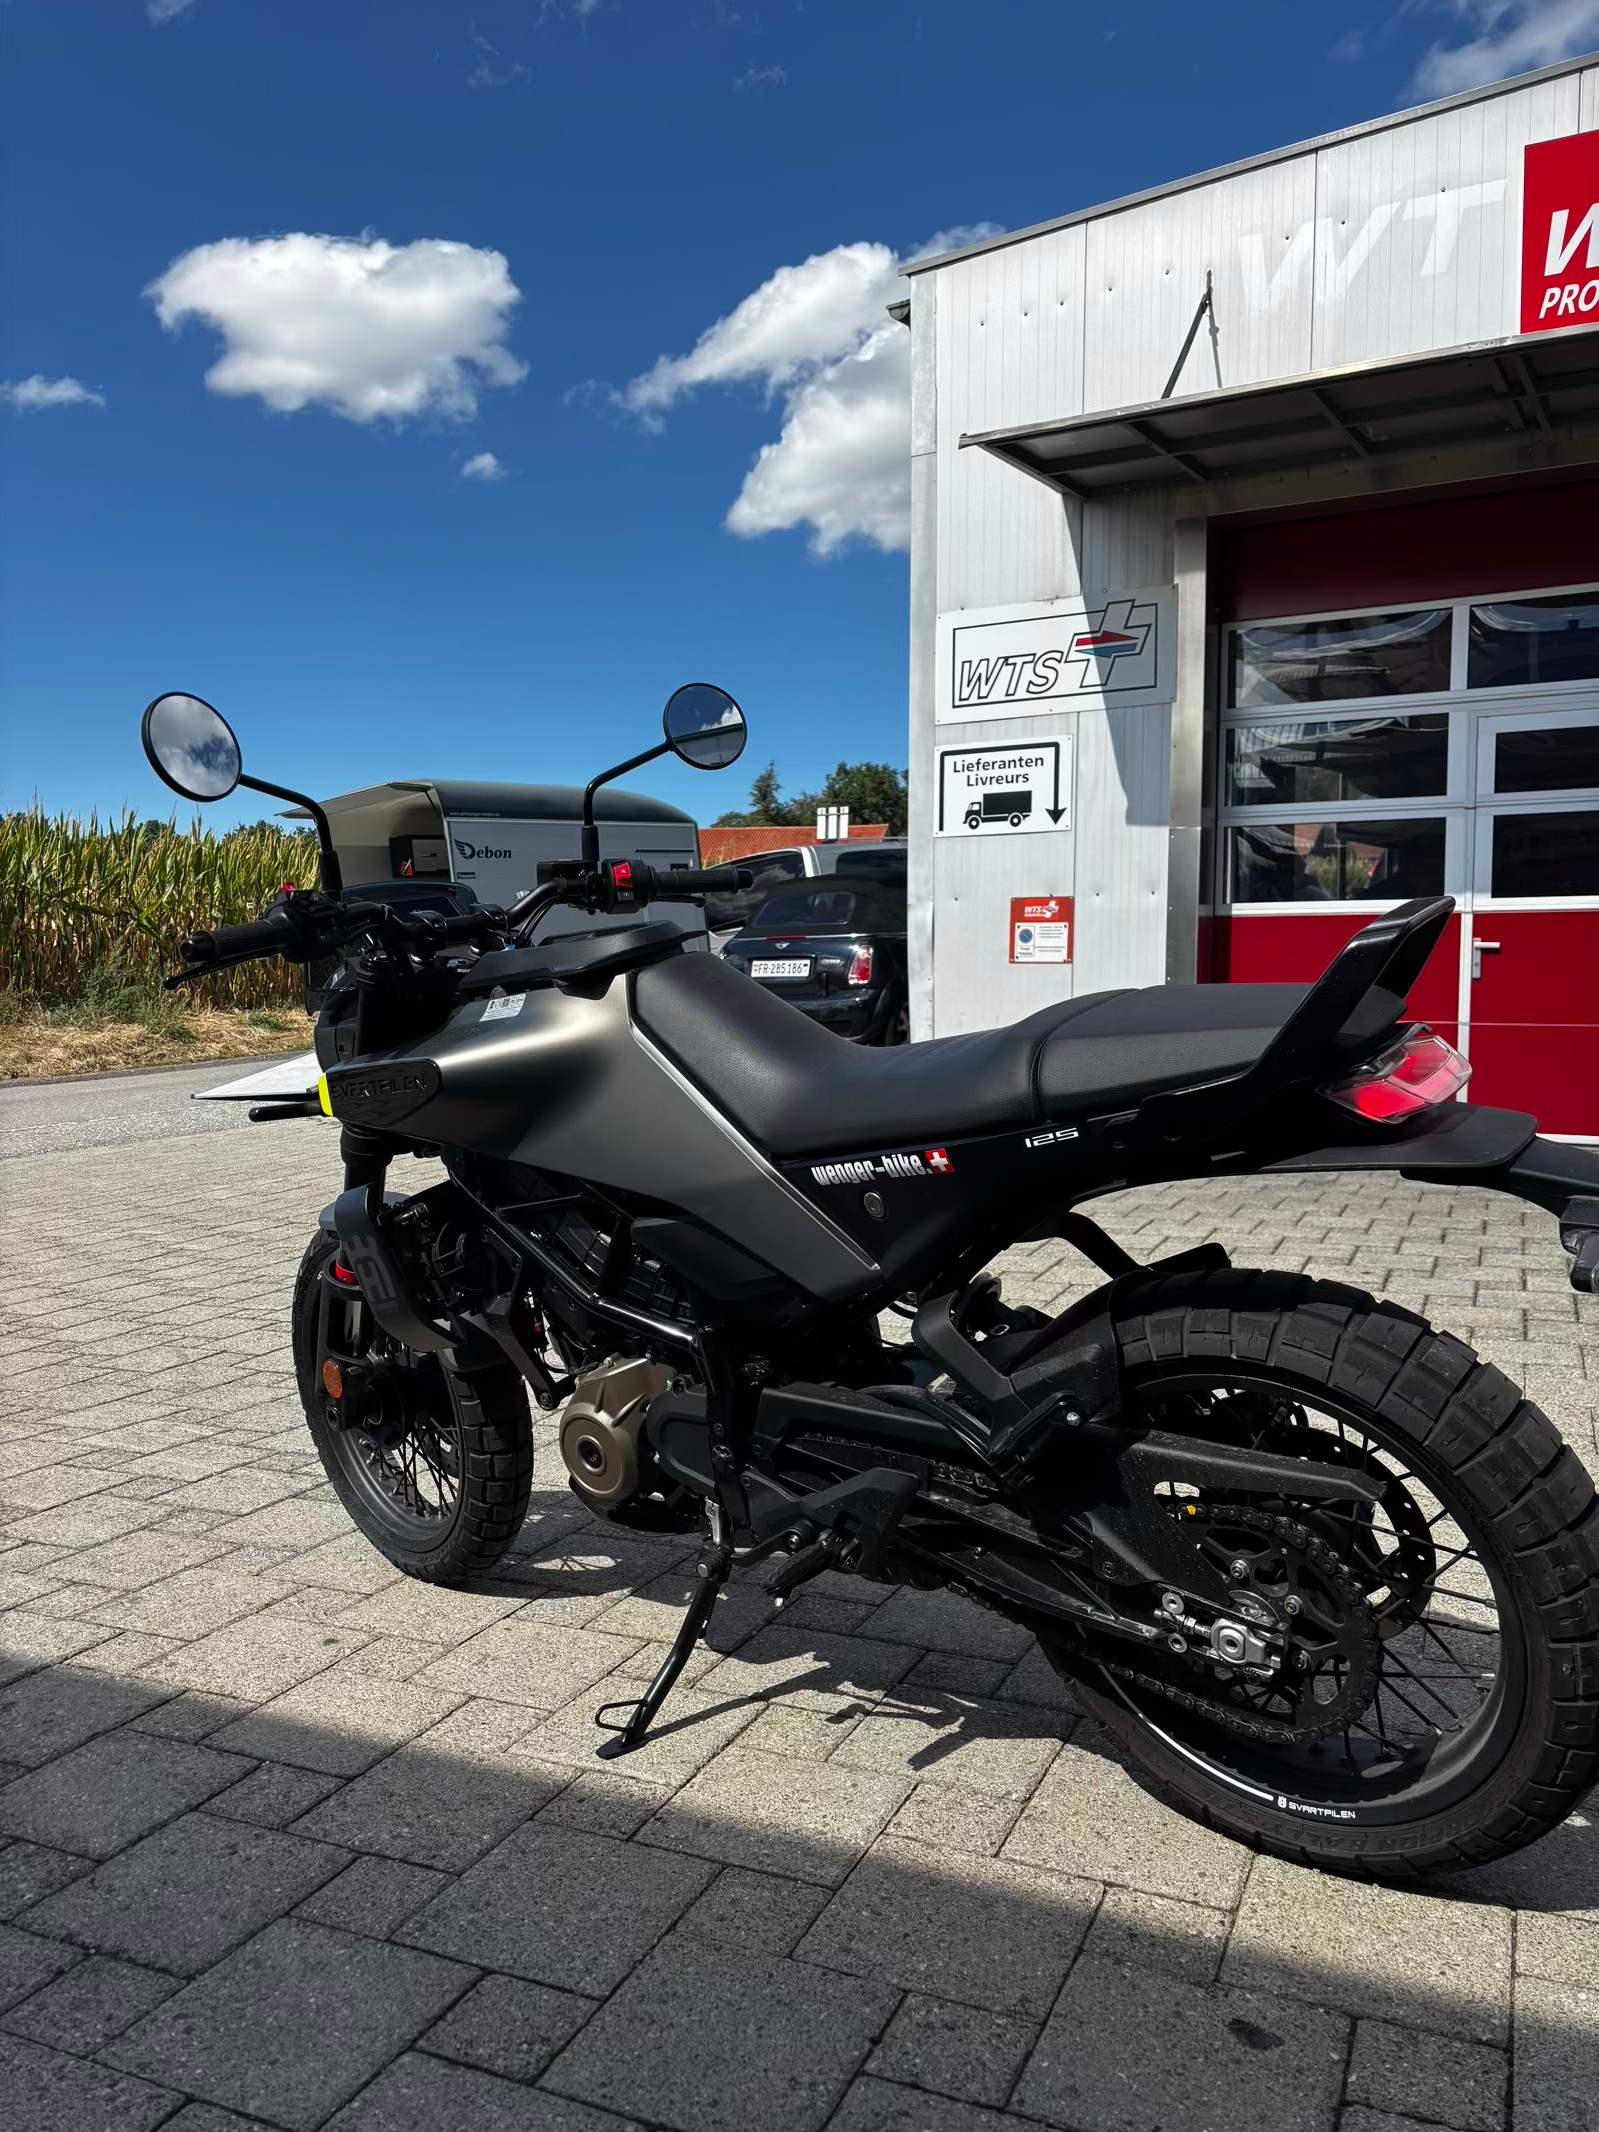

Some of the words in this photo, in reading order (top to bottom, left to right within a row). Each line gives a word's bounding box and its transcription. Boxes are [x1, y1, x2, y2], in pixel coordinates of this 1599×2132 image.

[958, 650, 1064, 702] WTS
[953, 755, 1045, 774] Lieferanten
[966, 771, 1030, 788] Livreurs
[453, 838, 513, 861] Debon
[1024, 1127, 1080, 1148] 125
[1288, 1801, 1357, 1819] SVARTPILEN
